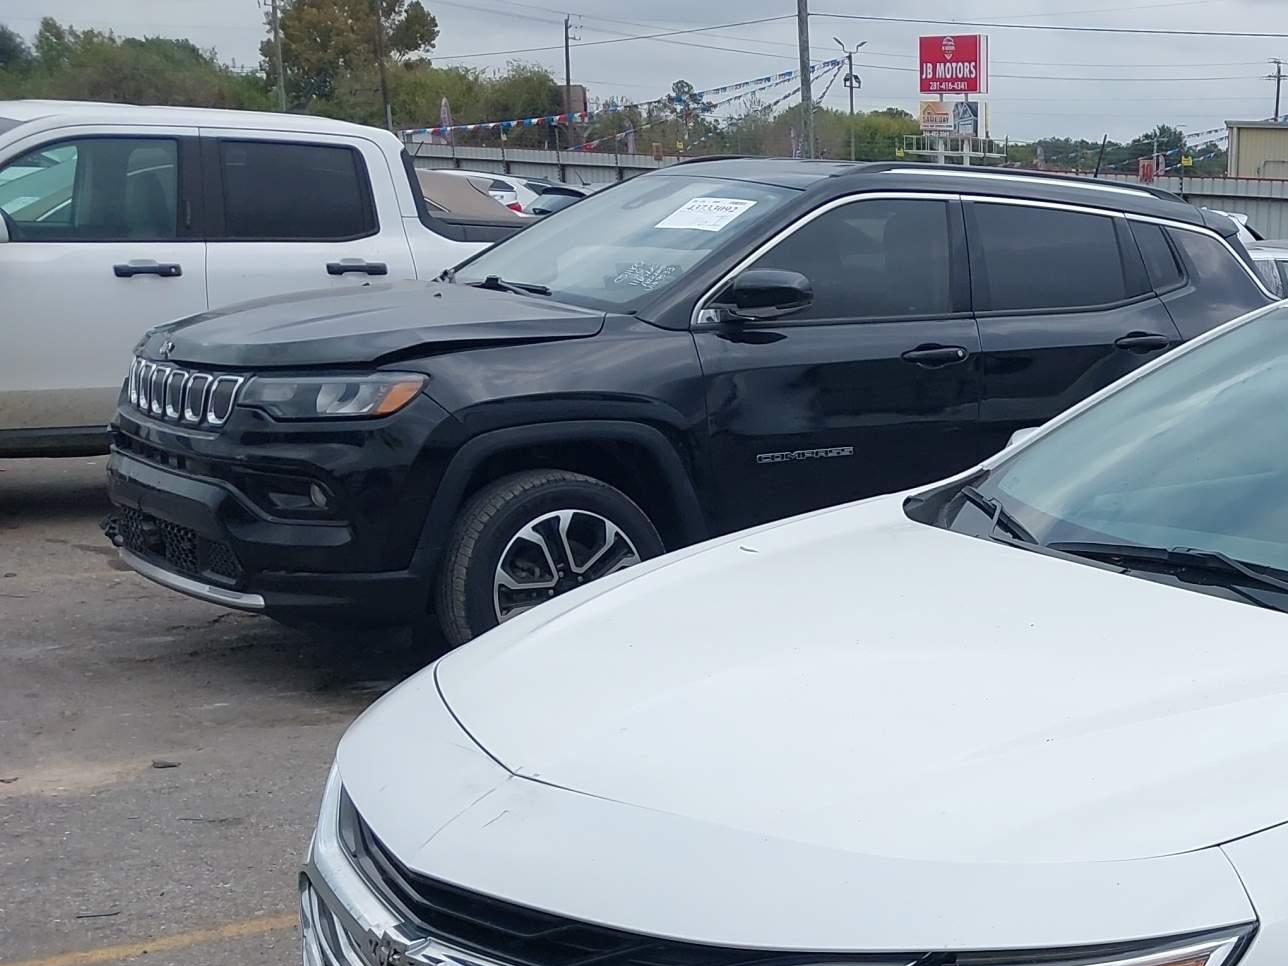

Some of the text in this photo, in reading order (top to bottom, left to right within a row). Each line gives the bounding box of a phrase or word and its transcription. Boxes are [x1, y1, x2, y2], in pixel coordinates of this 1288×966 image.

[922, 62, 976, 79] JB MOTORS
[756, 446, 854, 464] COMPASS
